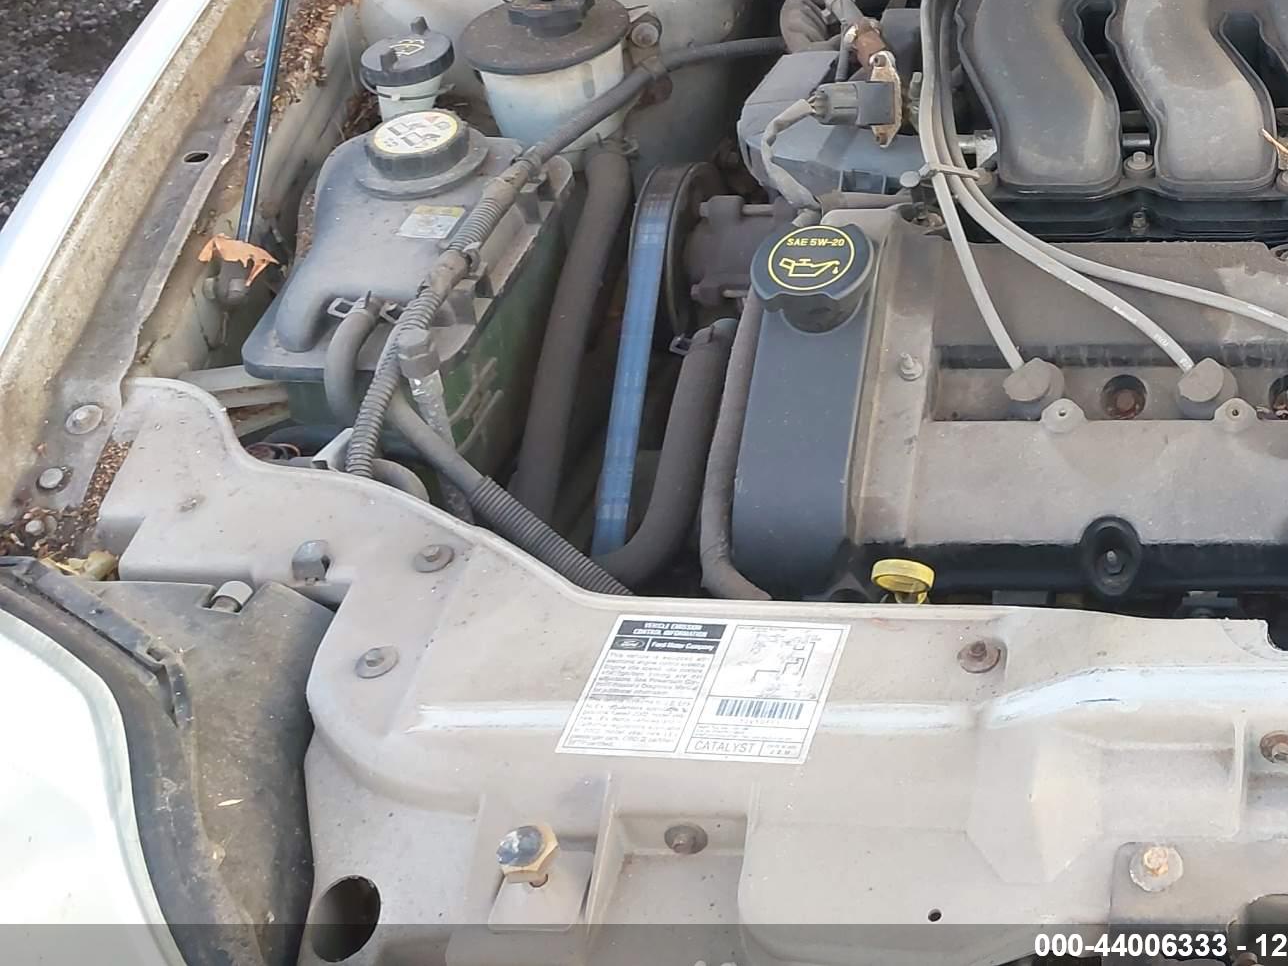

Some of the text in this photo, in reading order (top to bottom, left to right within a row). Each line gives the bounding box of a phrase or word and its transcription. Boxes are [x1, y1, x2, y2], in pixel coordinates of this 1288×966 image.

[786, 238, 845, 247] SAE 5W-20
[694, 740, 756, 753] CATALYST
